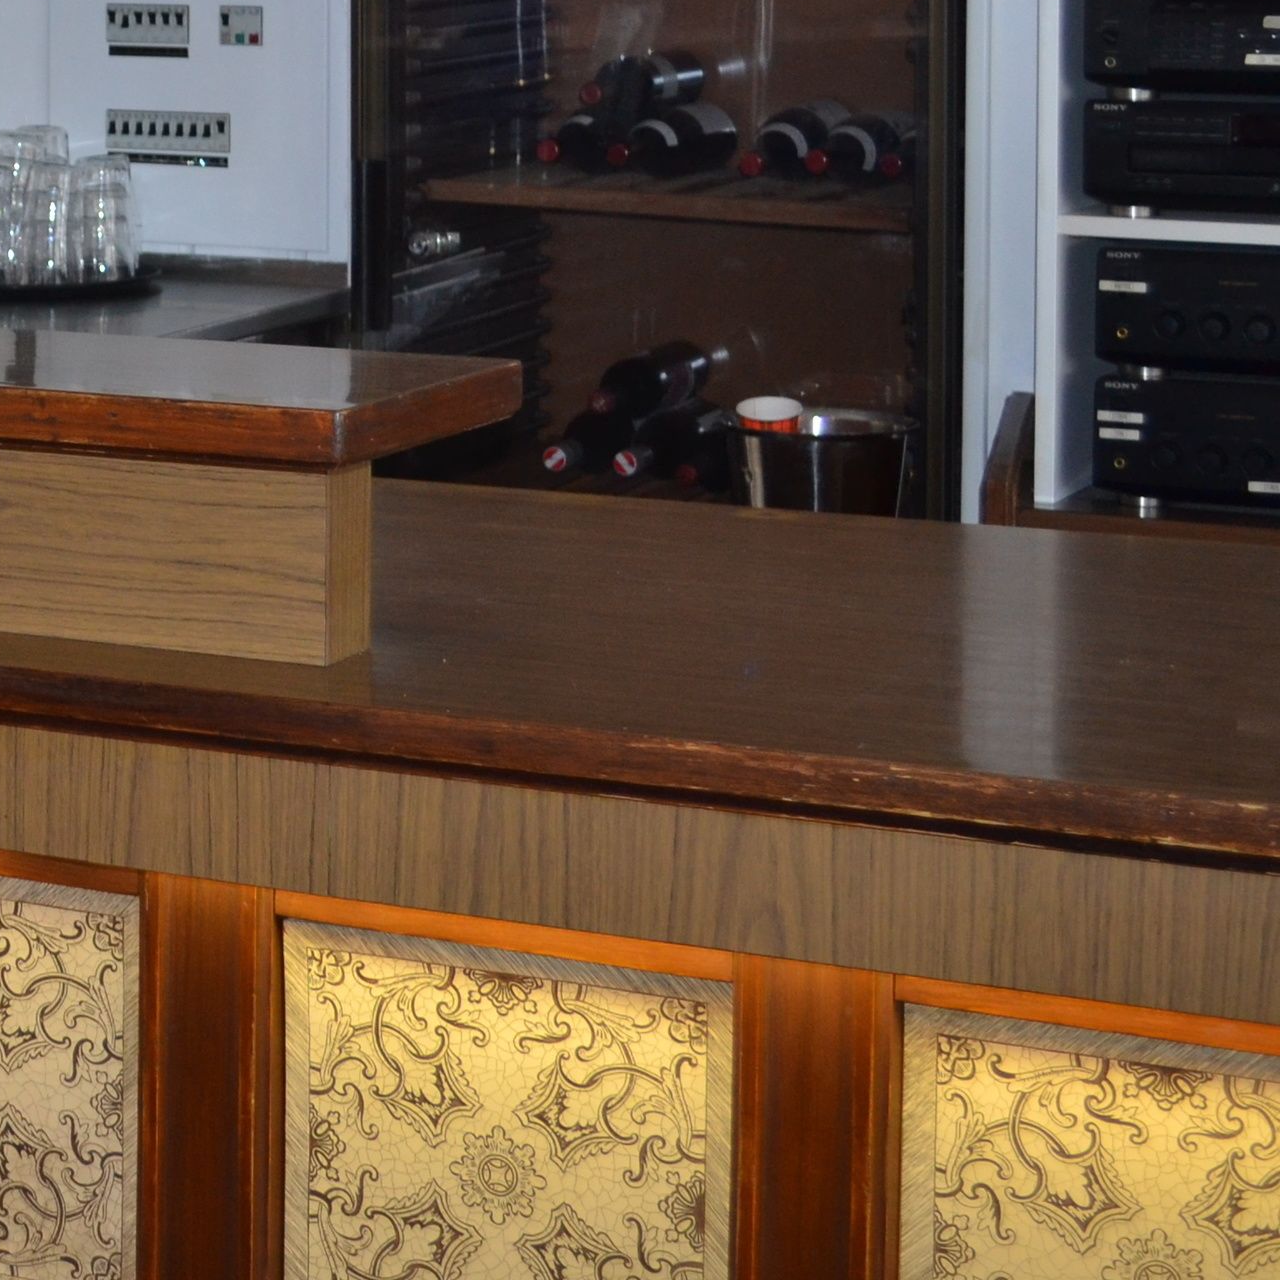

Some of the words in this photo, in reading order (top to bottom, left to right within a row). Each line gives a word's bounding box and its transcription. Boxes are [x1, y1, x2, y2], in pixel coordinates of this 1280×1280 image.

[1093, 102, 1127, 111] SONY
[1106, 251, 1141, 259] SONY
[1104, 381, 1139, 390] SONY
